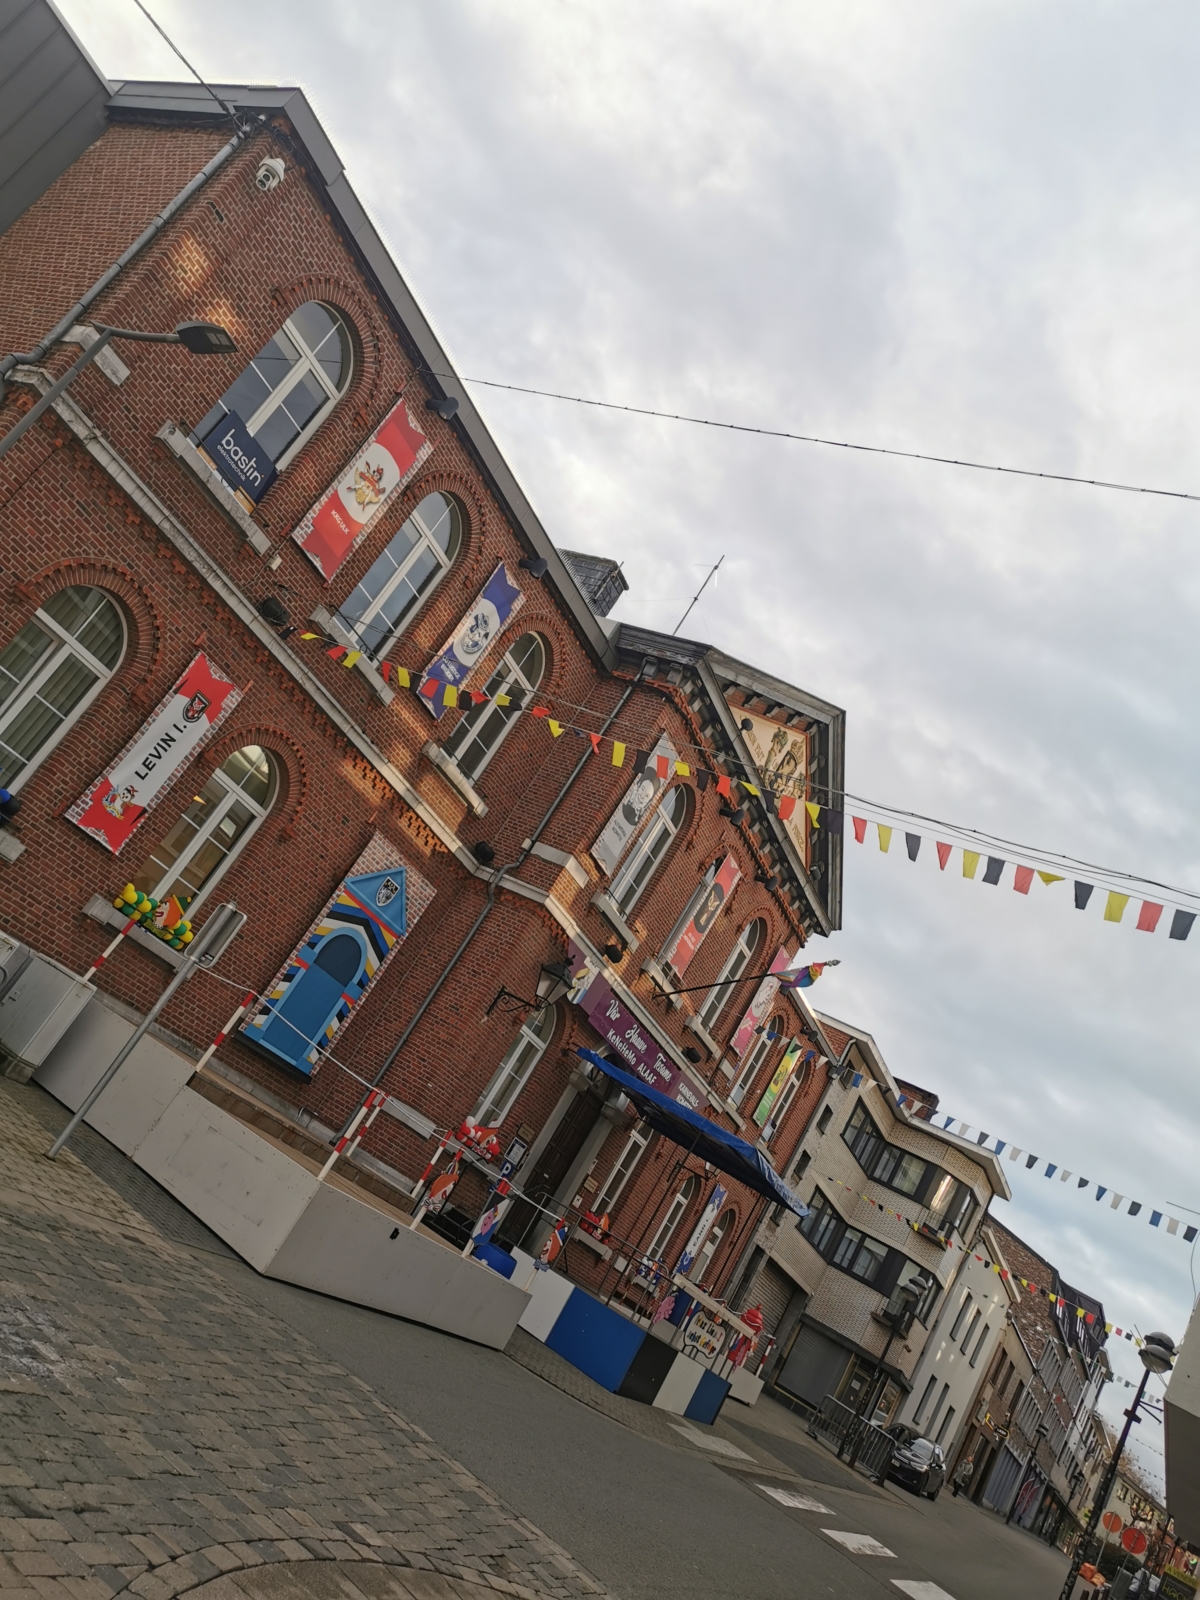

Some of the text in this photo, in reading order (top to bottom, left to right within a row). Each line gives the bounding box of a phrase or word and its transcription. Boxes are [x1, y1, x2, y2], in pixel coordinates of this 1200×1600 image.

[216, 445, 247, 481] elektrotechnik
[221, 428, 261, 487] bastin
[134, 723, 187, 781] LEVIN I.
[636, 1062, 657, 1085] ALAAF
[500, 1161, 512, 1177] P
